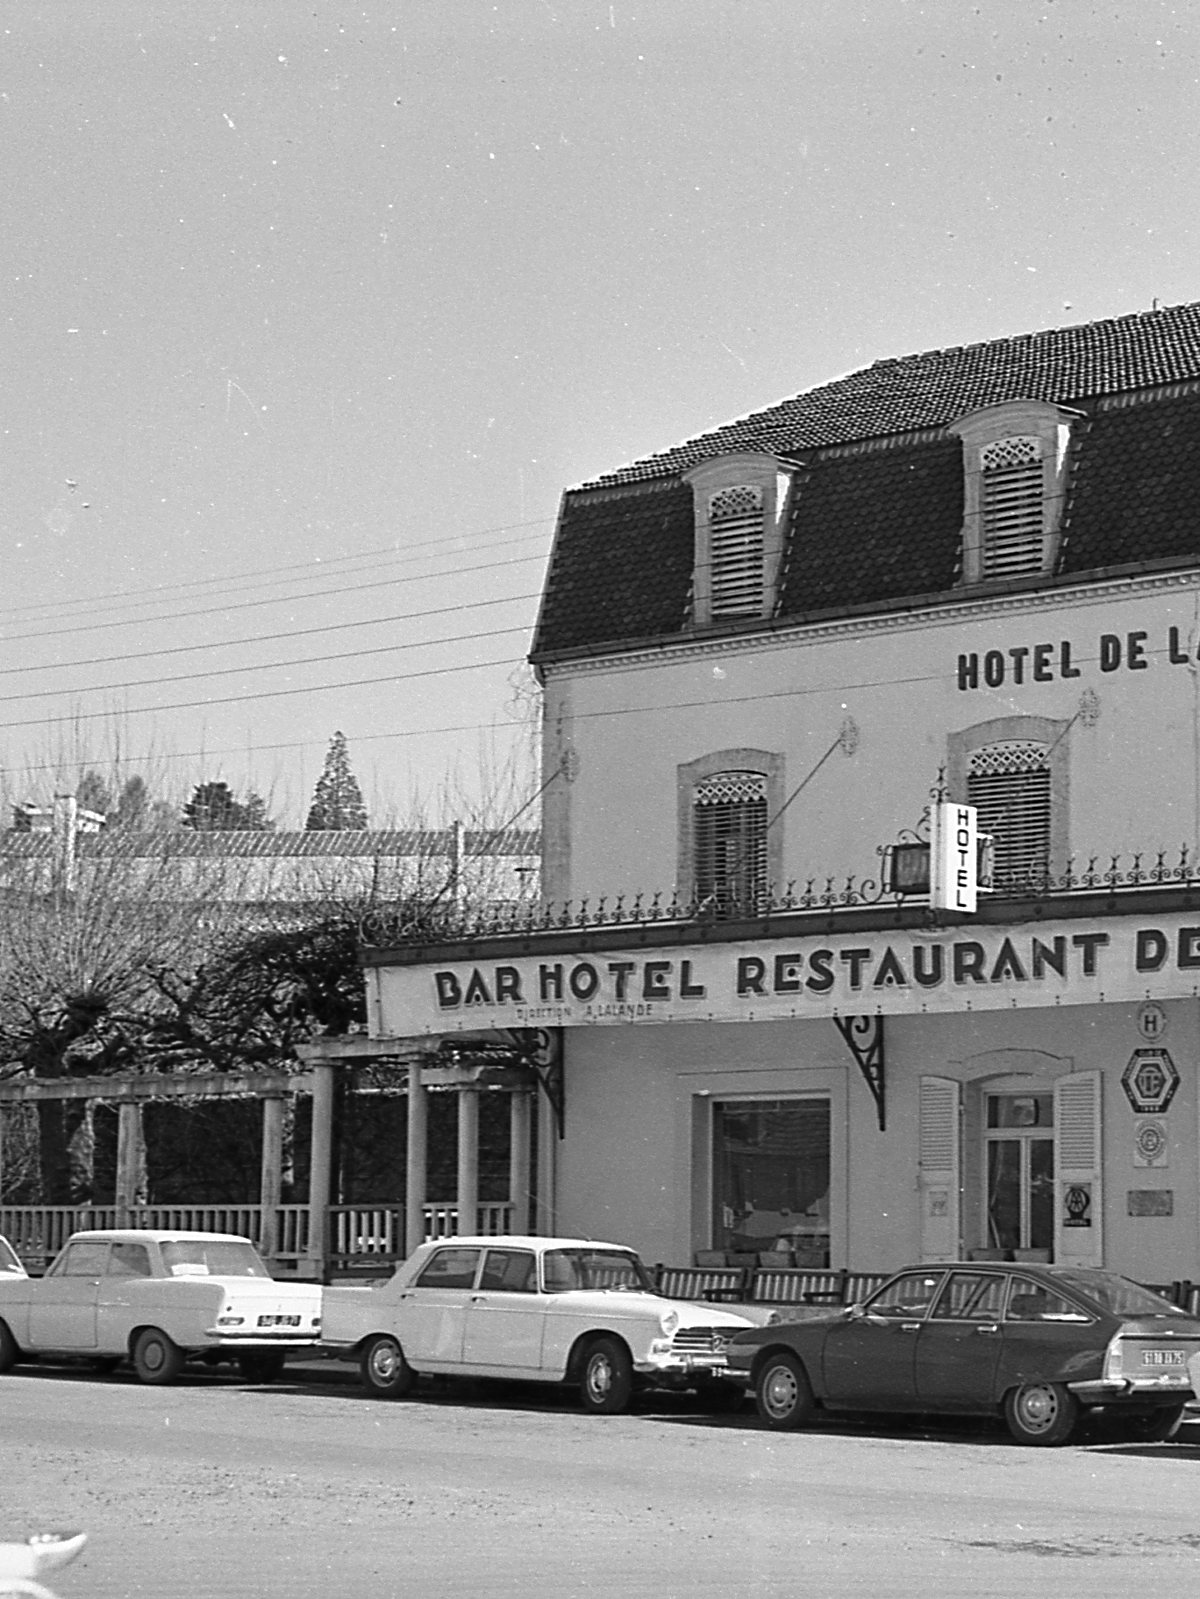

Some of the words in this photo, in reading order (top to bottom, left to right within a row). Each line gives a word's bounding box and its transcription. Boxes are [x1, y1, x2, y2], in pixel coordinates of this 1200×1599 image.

[957, 641, 1081, 691] HOTEL
[1100, 631, 1149, 673] DE
[957, 808, 969, 908] HOTEL
[434, 965, 527, 1011] BAR
[539, 959, 706, 1003] HOTEL
[737, 931, 1109, 998] RESTAURANT
[1144, 1014, 1157, 1032] H
